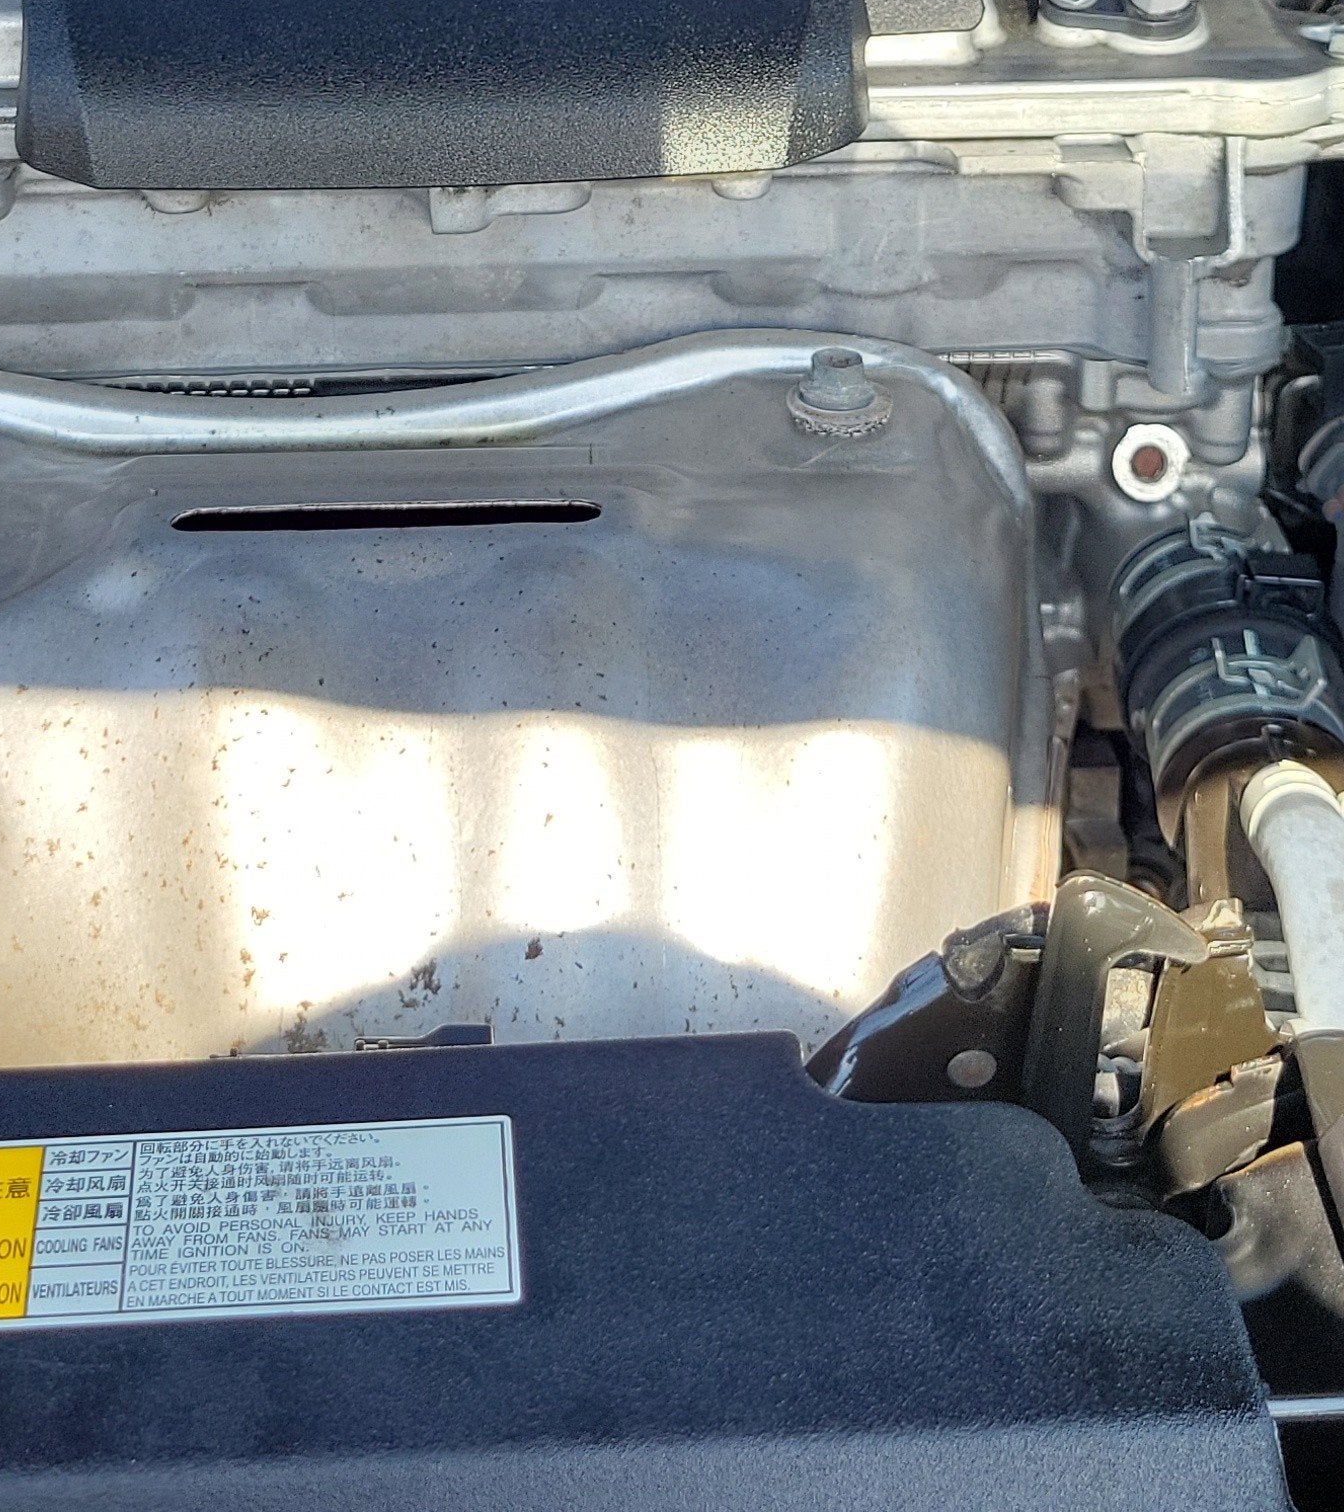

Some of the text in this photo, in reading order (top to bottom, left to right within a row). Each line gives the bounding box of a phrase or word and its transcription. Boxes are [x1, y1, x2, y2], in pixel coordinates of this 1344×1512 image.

[49, 1149, 129, 1165] 冷却ファン
[45, 1175, 126, 1193] 冷却风扇
[42, 1202, 124, 1222] 冷卻風扇
[132, 1224, 154, 1235] TO
[162, 1221, 210, 1234] AVOID
[219, 1217, 301, 1231] PERSONAL
[376, 1211, 415, 1223] KEEP
[424, 1207, 478, 1220] HANDS
[131, 1219, 492, 1248] AWAY FROM FANS. FANS MAY START AT ANY
[36, 1236, 123, 1255] COOLING FANS
[131, 1241, 309, 1260] TIME IGNITION IS ON.
[129, 1246, 505, 1276] POUR ÉVITER TOUTE BLESSURE, NE PAS POSER LES MAINS
[139, 1279, 164, 1290] CET
[169, 1275, 229, 1290] ENDROIT,
[233, 1274, 257, 1286] LES
[260, 1269, 355, 1284] VENTILATEURS
[359, 1266, 418, 1280] PEUVENT
[422, 1265, 439, 1276] SE
[442, 1262, 495, 1275] METTRE
[33, 1279, 118, 1299] VENTILATEURS
[126, 1295, 144, 1307] EN
[148, 1292, 204, 1306] MARCHE
[219, 1289, 253, 1302] TOUT
[258, 1286, 314, 1300] MOMENT
[317, 1286, 329, 1297] SI
[332, 1284, 347, 1296] LE
[352, 1281, 412, 1295] CONTACT
[417, 1280, 442, 1292] EST
[444, 1278, 469, 1291] MIS.
